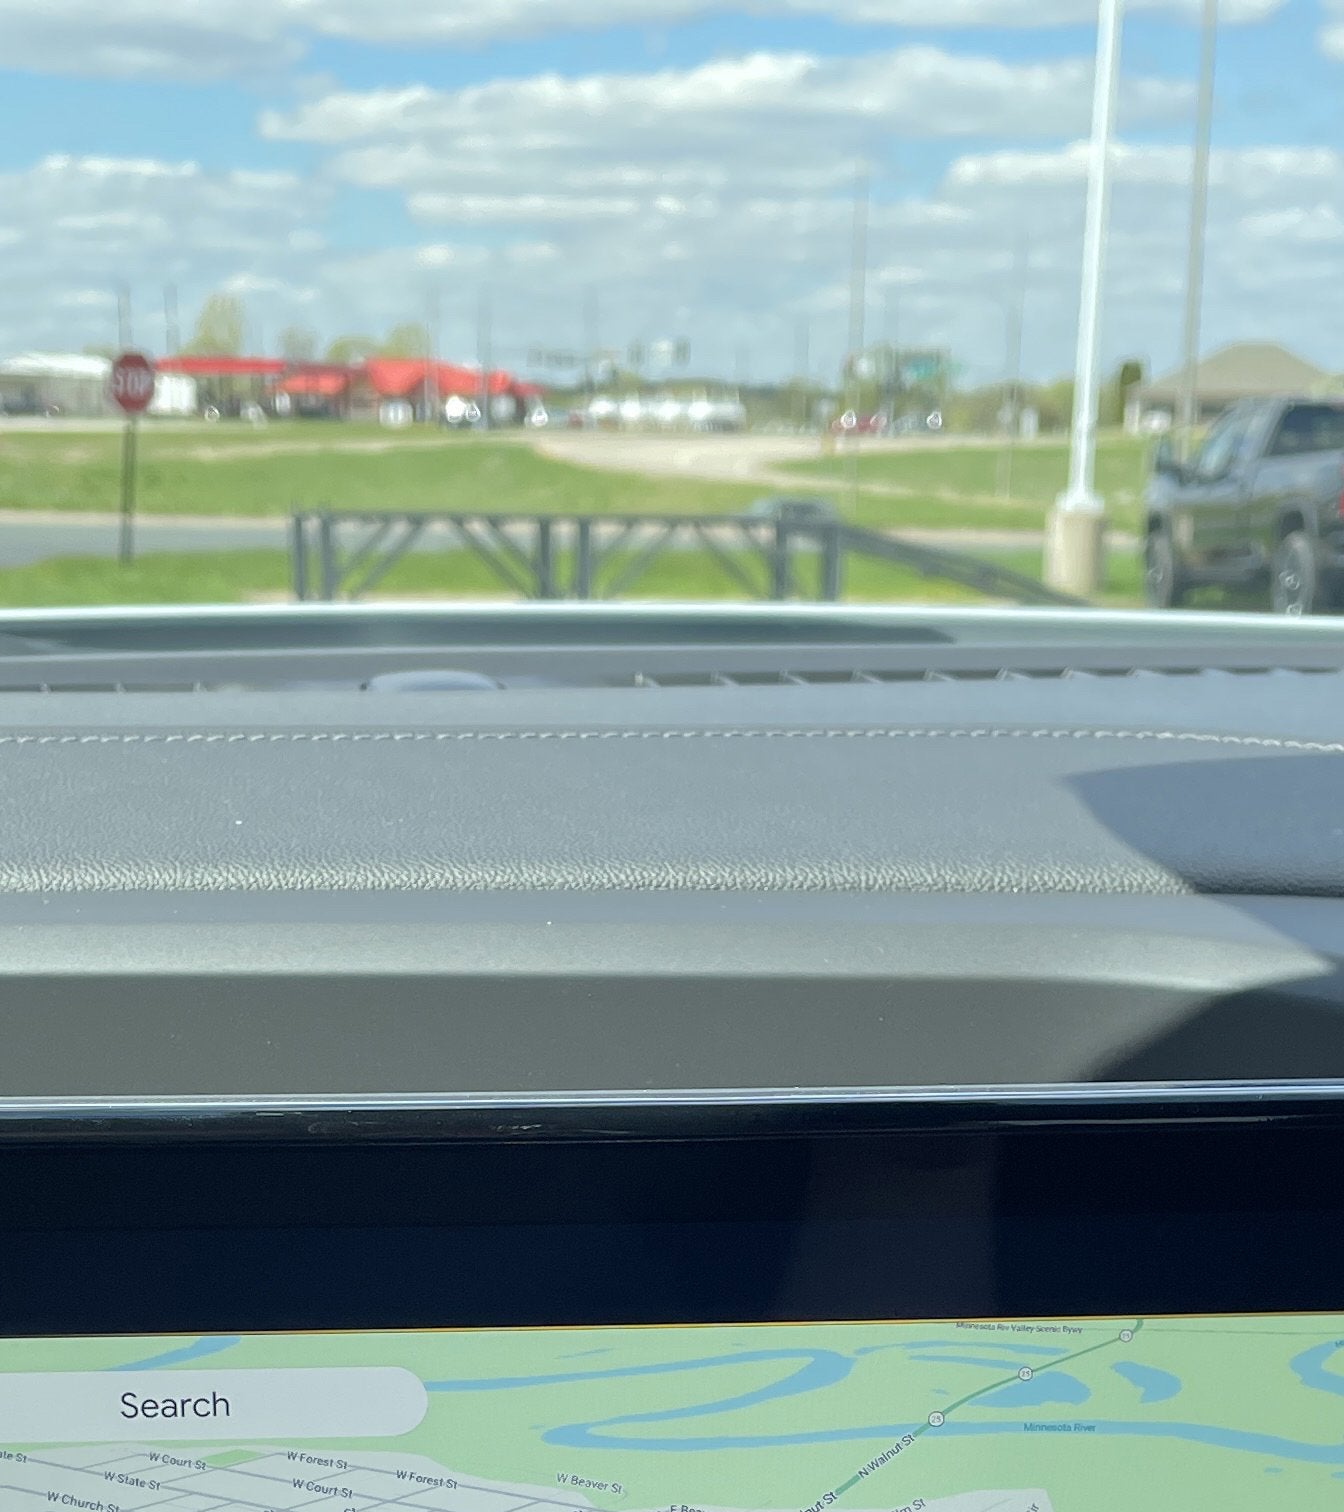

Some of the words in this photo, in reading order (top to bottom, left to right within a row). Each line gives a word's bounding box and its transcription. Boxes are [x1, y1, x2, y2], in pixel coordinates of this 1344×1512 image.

[120, 1391, 231, 1420] Search
[293, 1479, 306, 1488] W
[307, 1482, 338, 1494] Court
[341, 1488, 352, 1498] St
[823, 1492, 837, 1504] St
